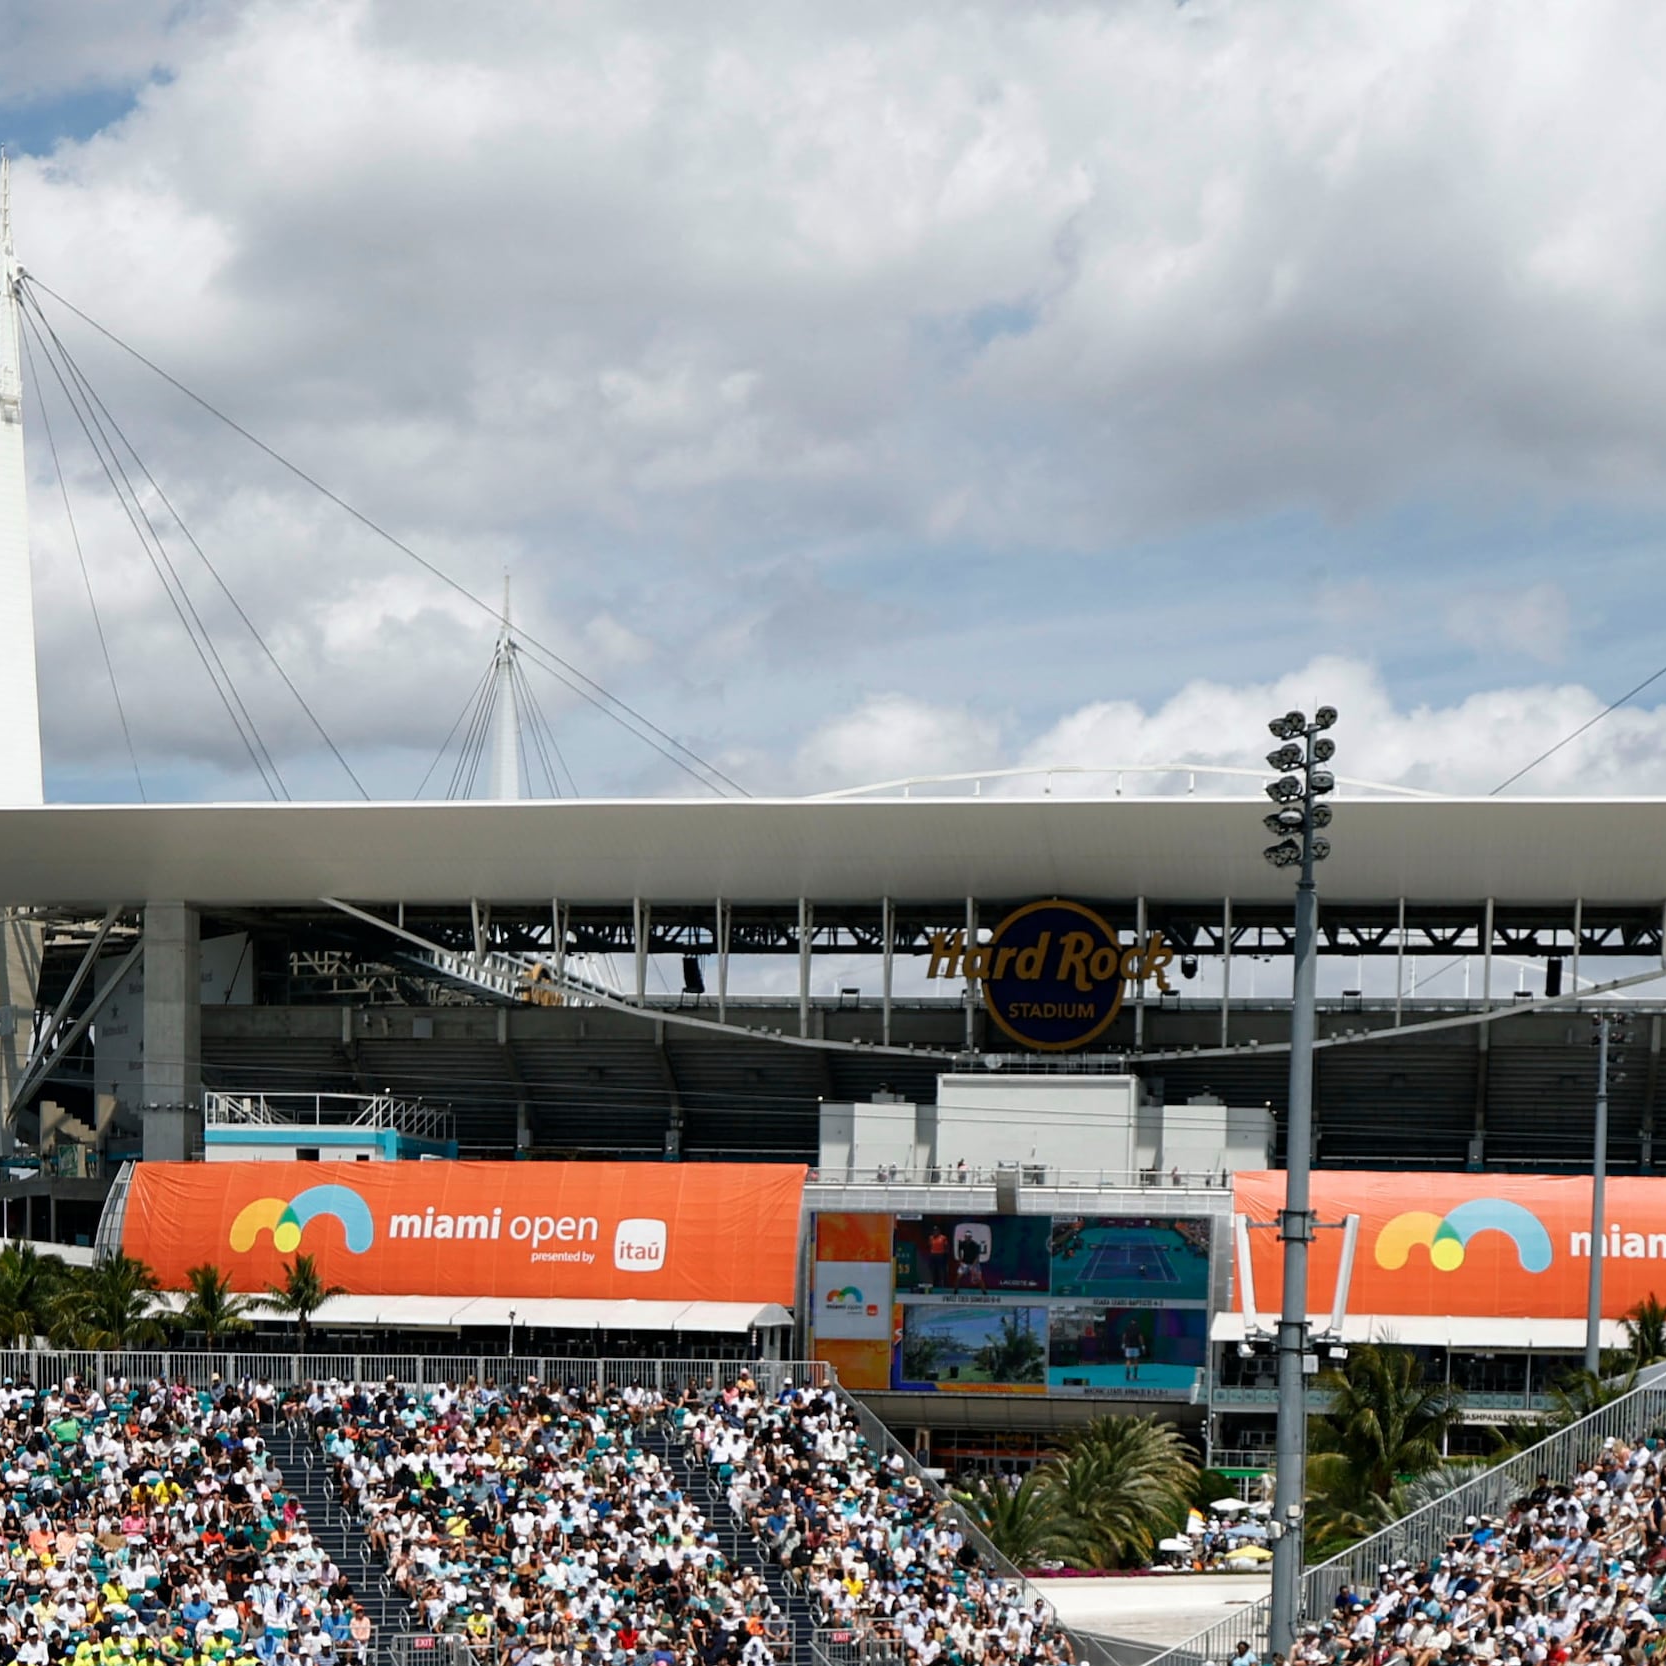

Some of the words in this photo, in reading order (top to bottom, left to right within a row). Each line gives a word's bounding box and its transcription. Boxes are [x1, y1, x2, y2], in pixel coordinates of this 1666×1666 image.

[927, 931, 1052, 981] Hard
[1056, 931, 1174, 992] Rock
[1008, 1002, 1095, 1020] STADIUM
[389, 1207, 501, 1240] miami
[510, 1211, 598, 1248] open
[531, 1250, 573, 1265] presented
[577, 1250, 595, 1265] by
[619, 1242, 660, 1262] itaú
[415, 1638, 432, 1648] EXIT
[834, 1632, 849, 1641] EXIT
